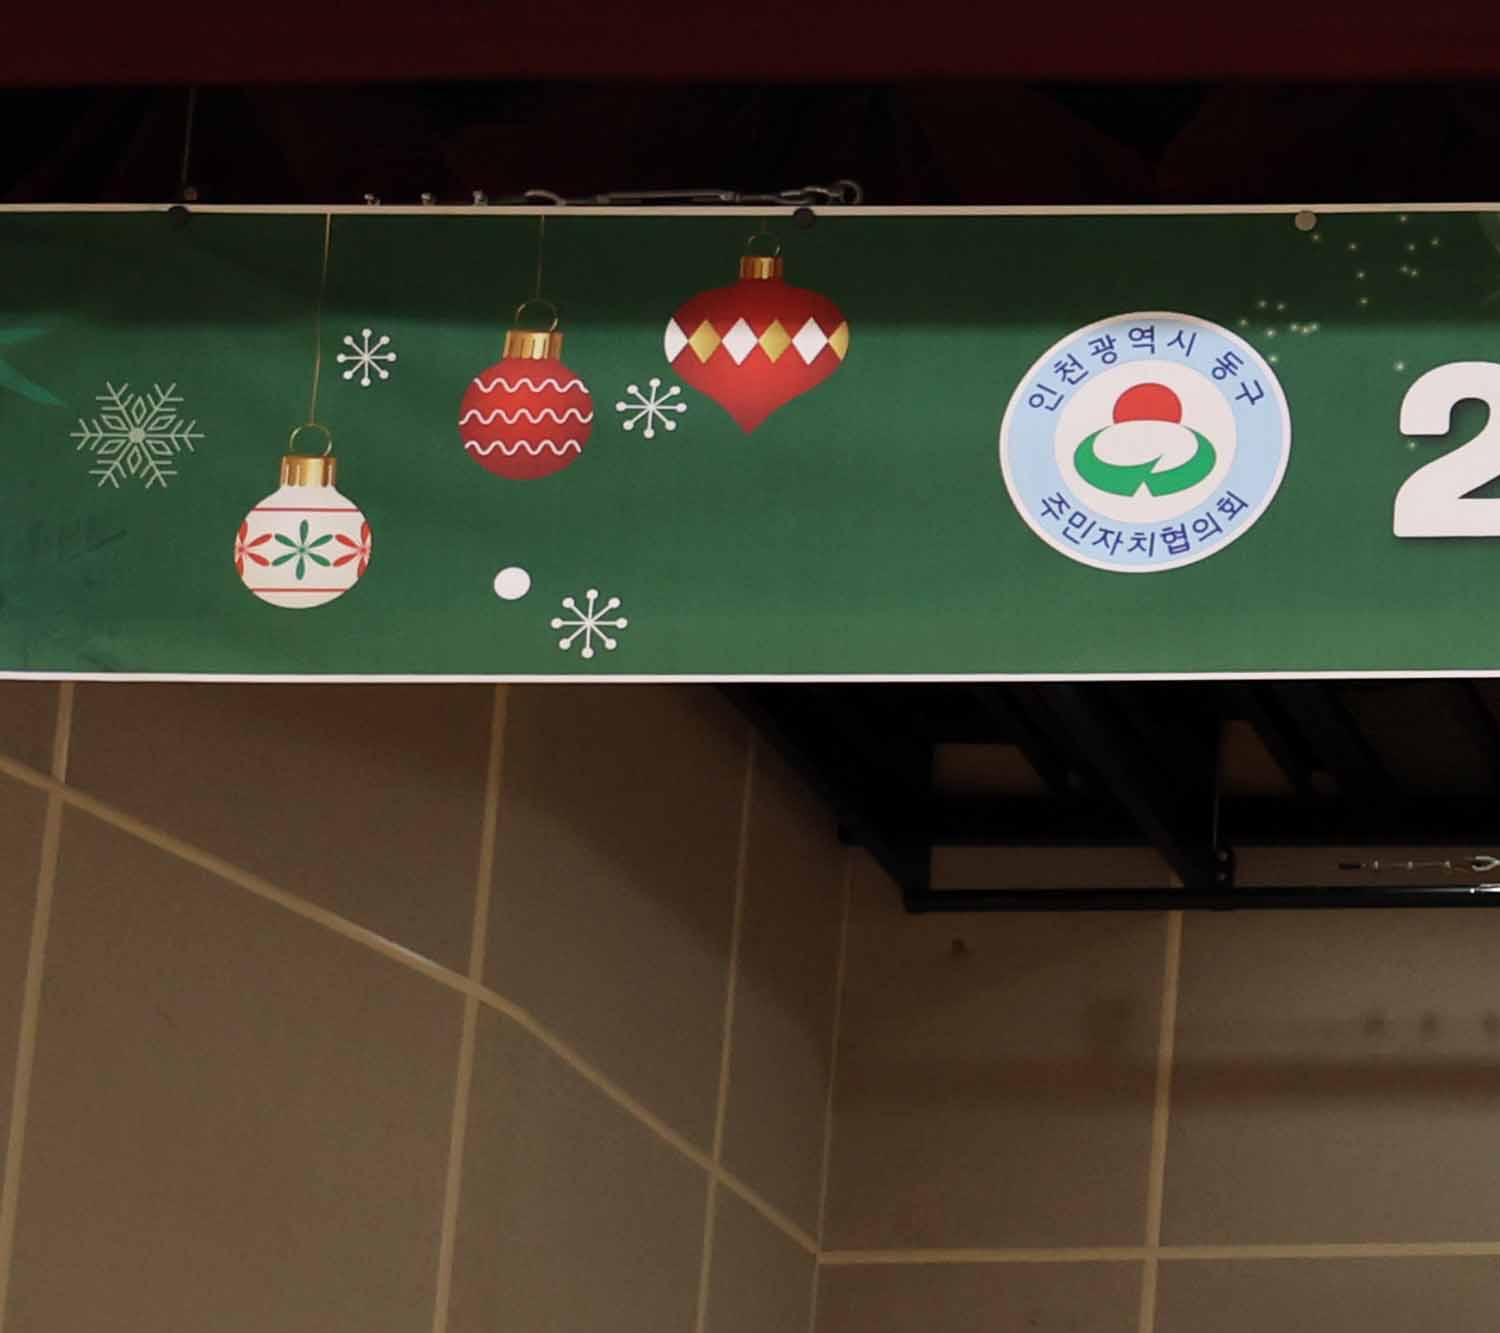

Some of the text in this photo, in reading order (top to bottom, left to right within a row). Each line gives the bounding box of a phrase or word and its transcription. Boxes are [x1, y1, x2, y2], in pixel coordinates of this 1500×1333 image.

[1028, 325, 1265, 412] 인천광역시 동구
[1041, 491, 1249, 557] 주민자치협의회
